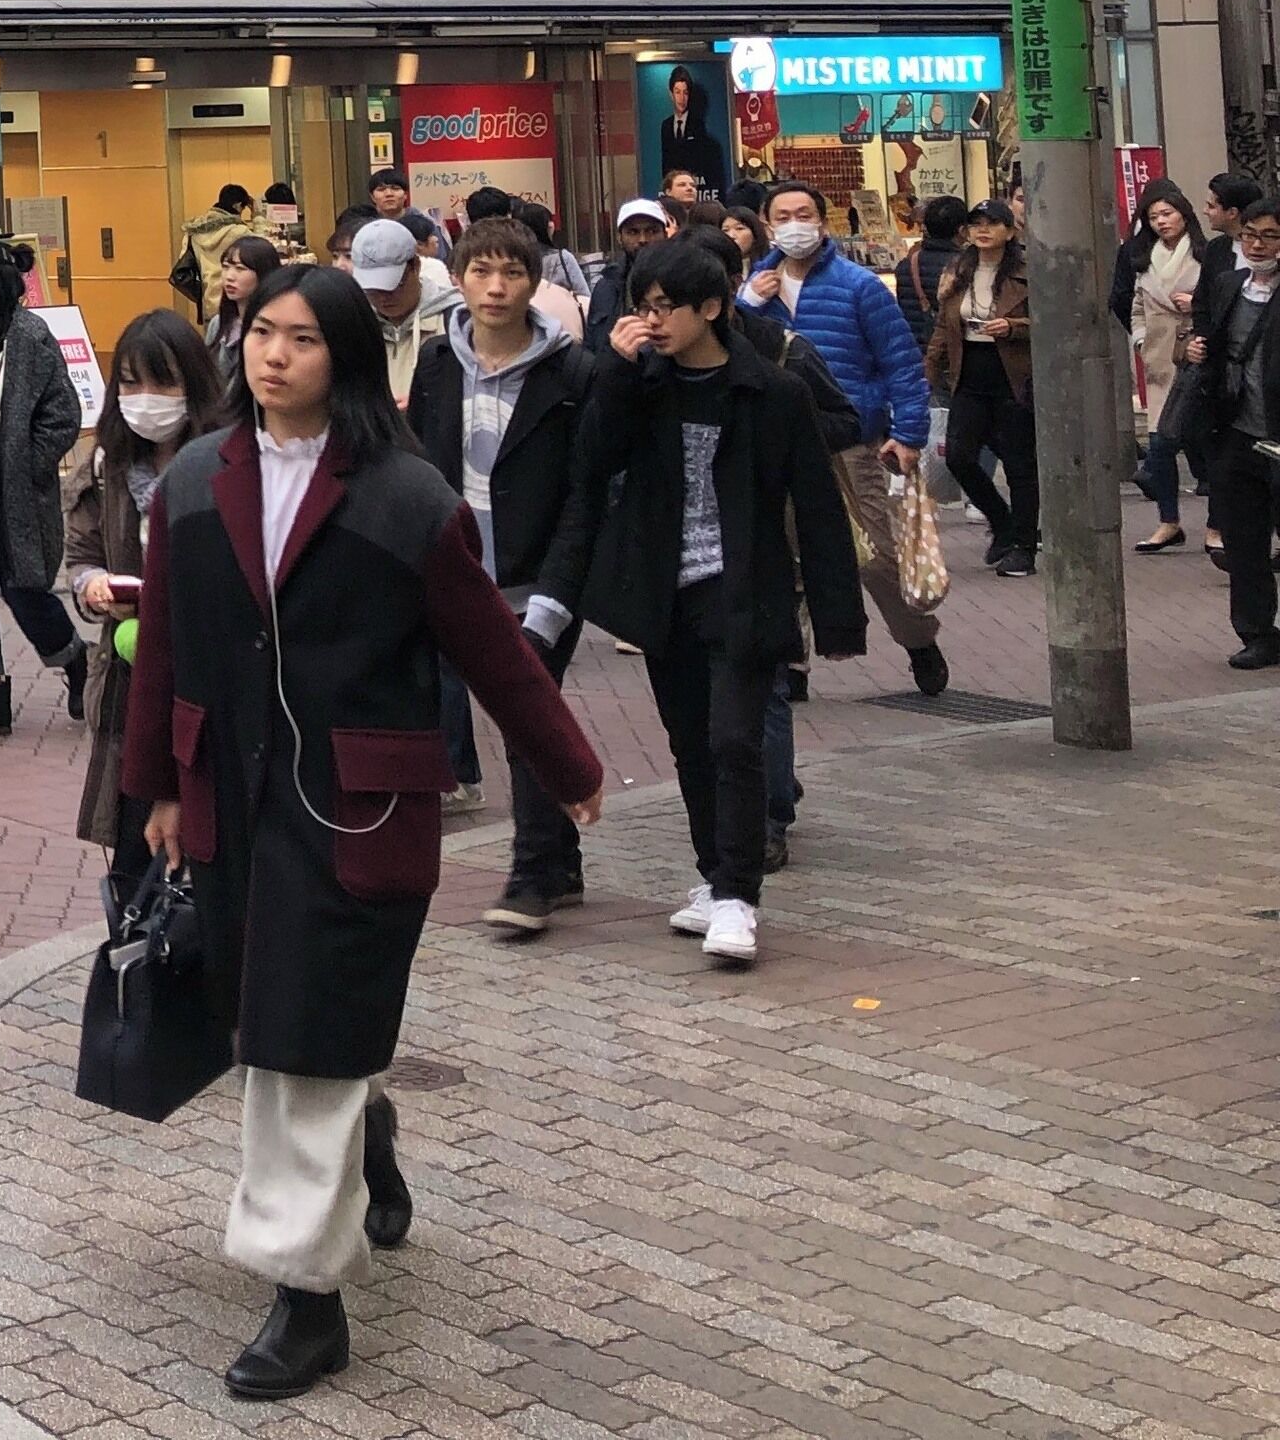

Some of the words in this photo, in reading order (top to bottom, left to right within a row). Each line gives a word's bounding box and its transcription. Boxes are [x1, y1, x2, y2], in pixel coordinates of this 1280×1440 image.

[782, 56, 891, 86] MISTER
[897, 54, 986, 84] MINIT
[410, 107, 548, 145] goodprice
[918, 167, 946, 181] かかと
[60, 343, 88, 360] FREE
